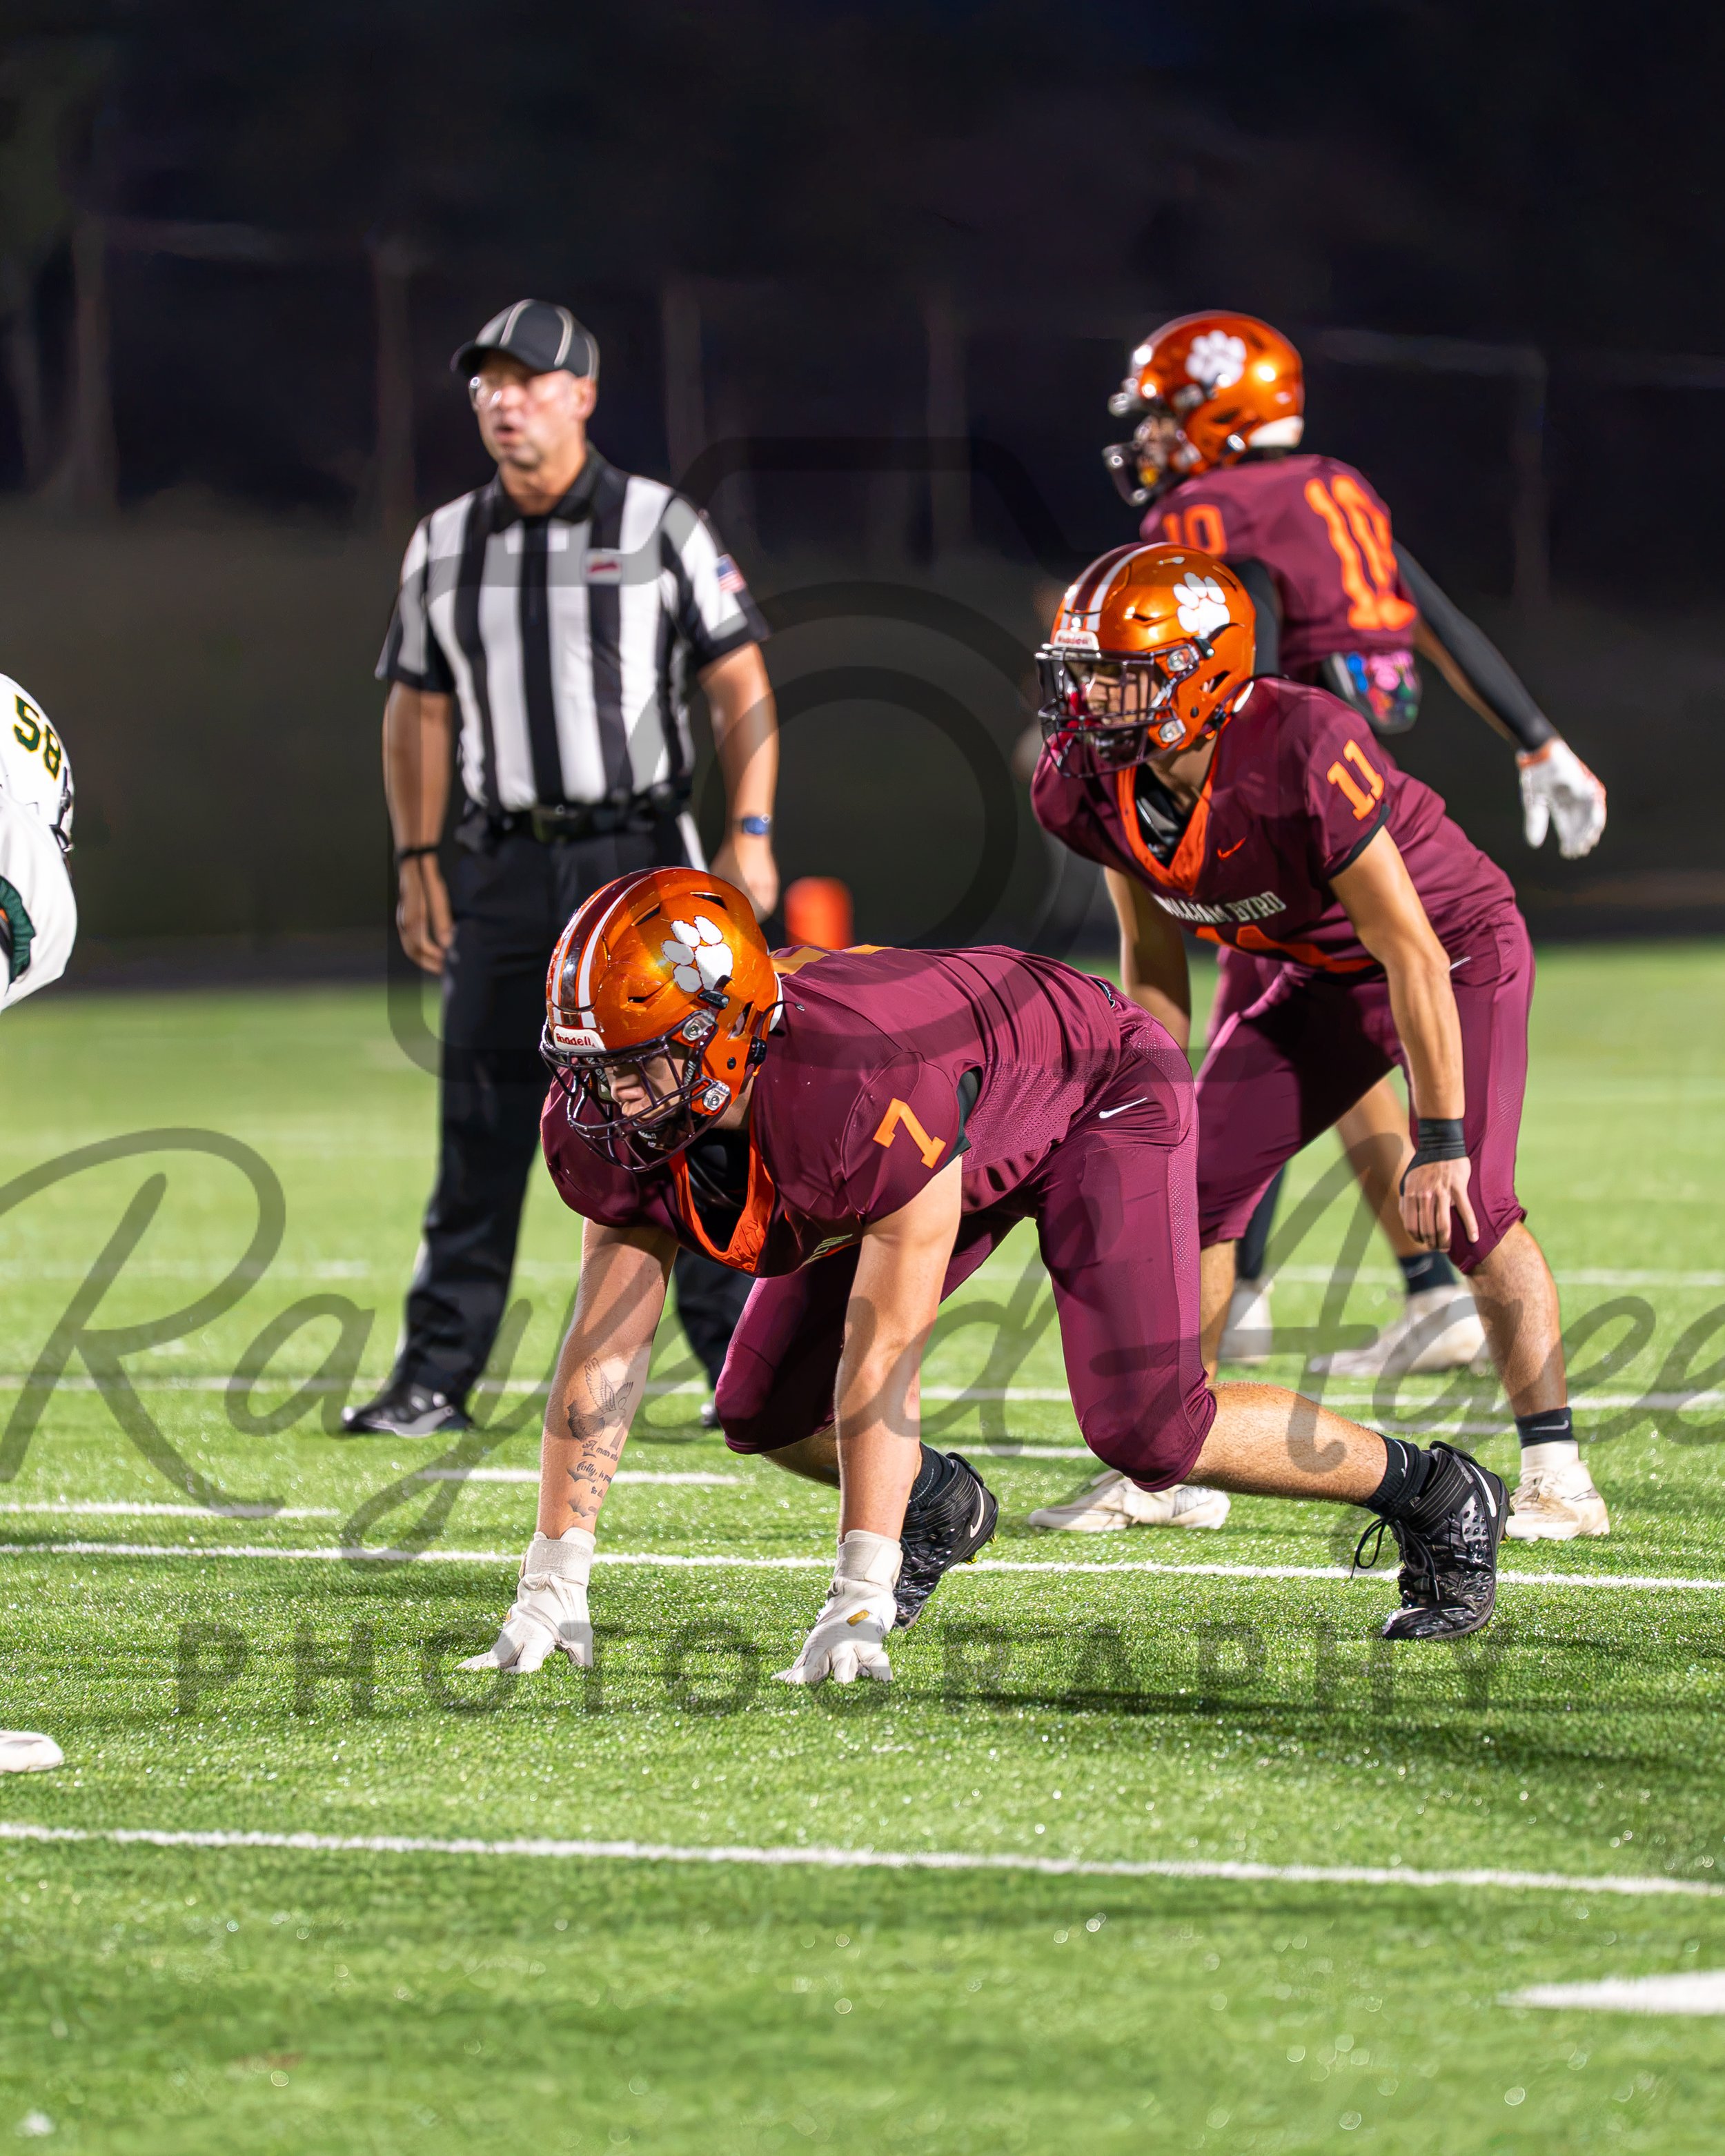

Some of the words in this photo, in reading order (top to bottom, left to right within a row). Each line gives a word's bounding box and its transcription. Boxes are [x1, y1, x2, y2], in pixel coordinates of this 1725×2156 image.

[1163, 504, 1228, 558] 10
[1304, 474, 1417, 631] 10
[13, 693, 61, 780] 58
[1326, 739, 1385, 821] 11
[872, 1098, 947, 1169] 7
